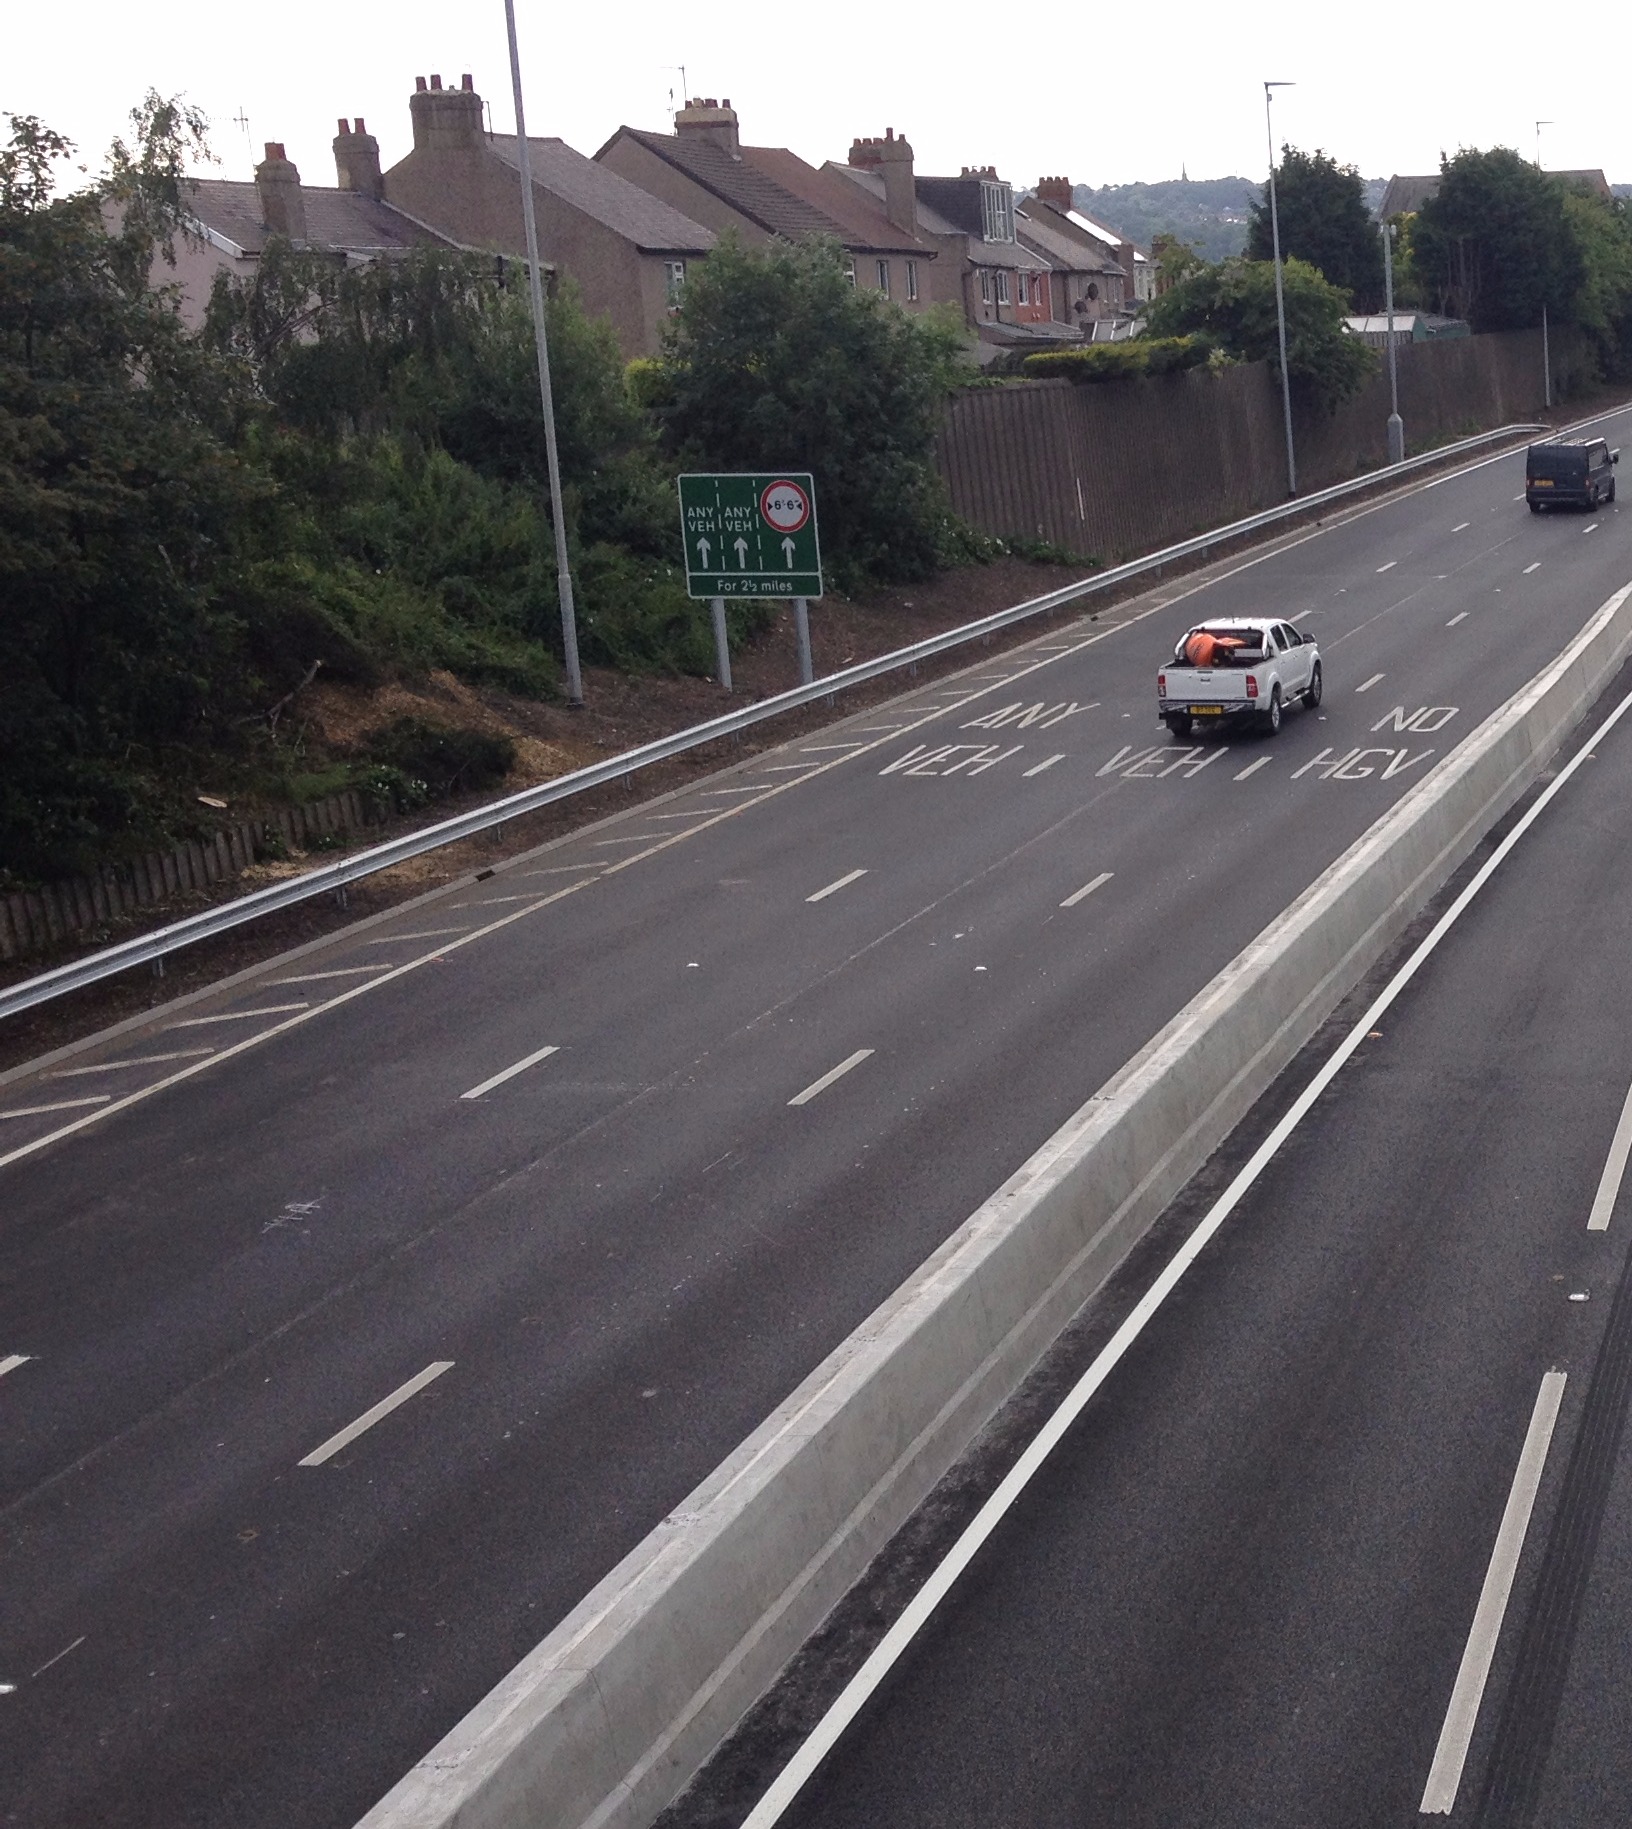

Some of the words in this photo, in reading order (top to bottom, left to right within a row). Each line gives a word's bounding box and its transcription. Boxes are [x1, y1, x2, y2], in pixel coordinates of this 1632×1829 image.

[687, 506, 714, 518] ANY
[724, 506, 751, 518] ANY
[688, 521, 715, 532] VEH
[725, 521, 752, 532] VEH
[717, 580, 736, 591] For
[761, 580, 793, 591] miles
[958, 702, 1101, 729] ANY
[1370, 705, 1459, 732] NO
[878, 744, 1025, 776] VEH
[1095, 745, 1229, 778] VEH
[1290, 747, 1436, 781] HGV
